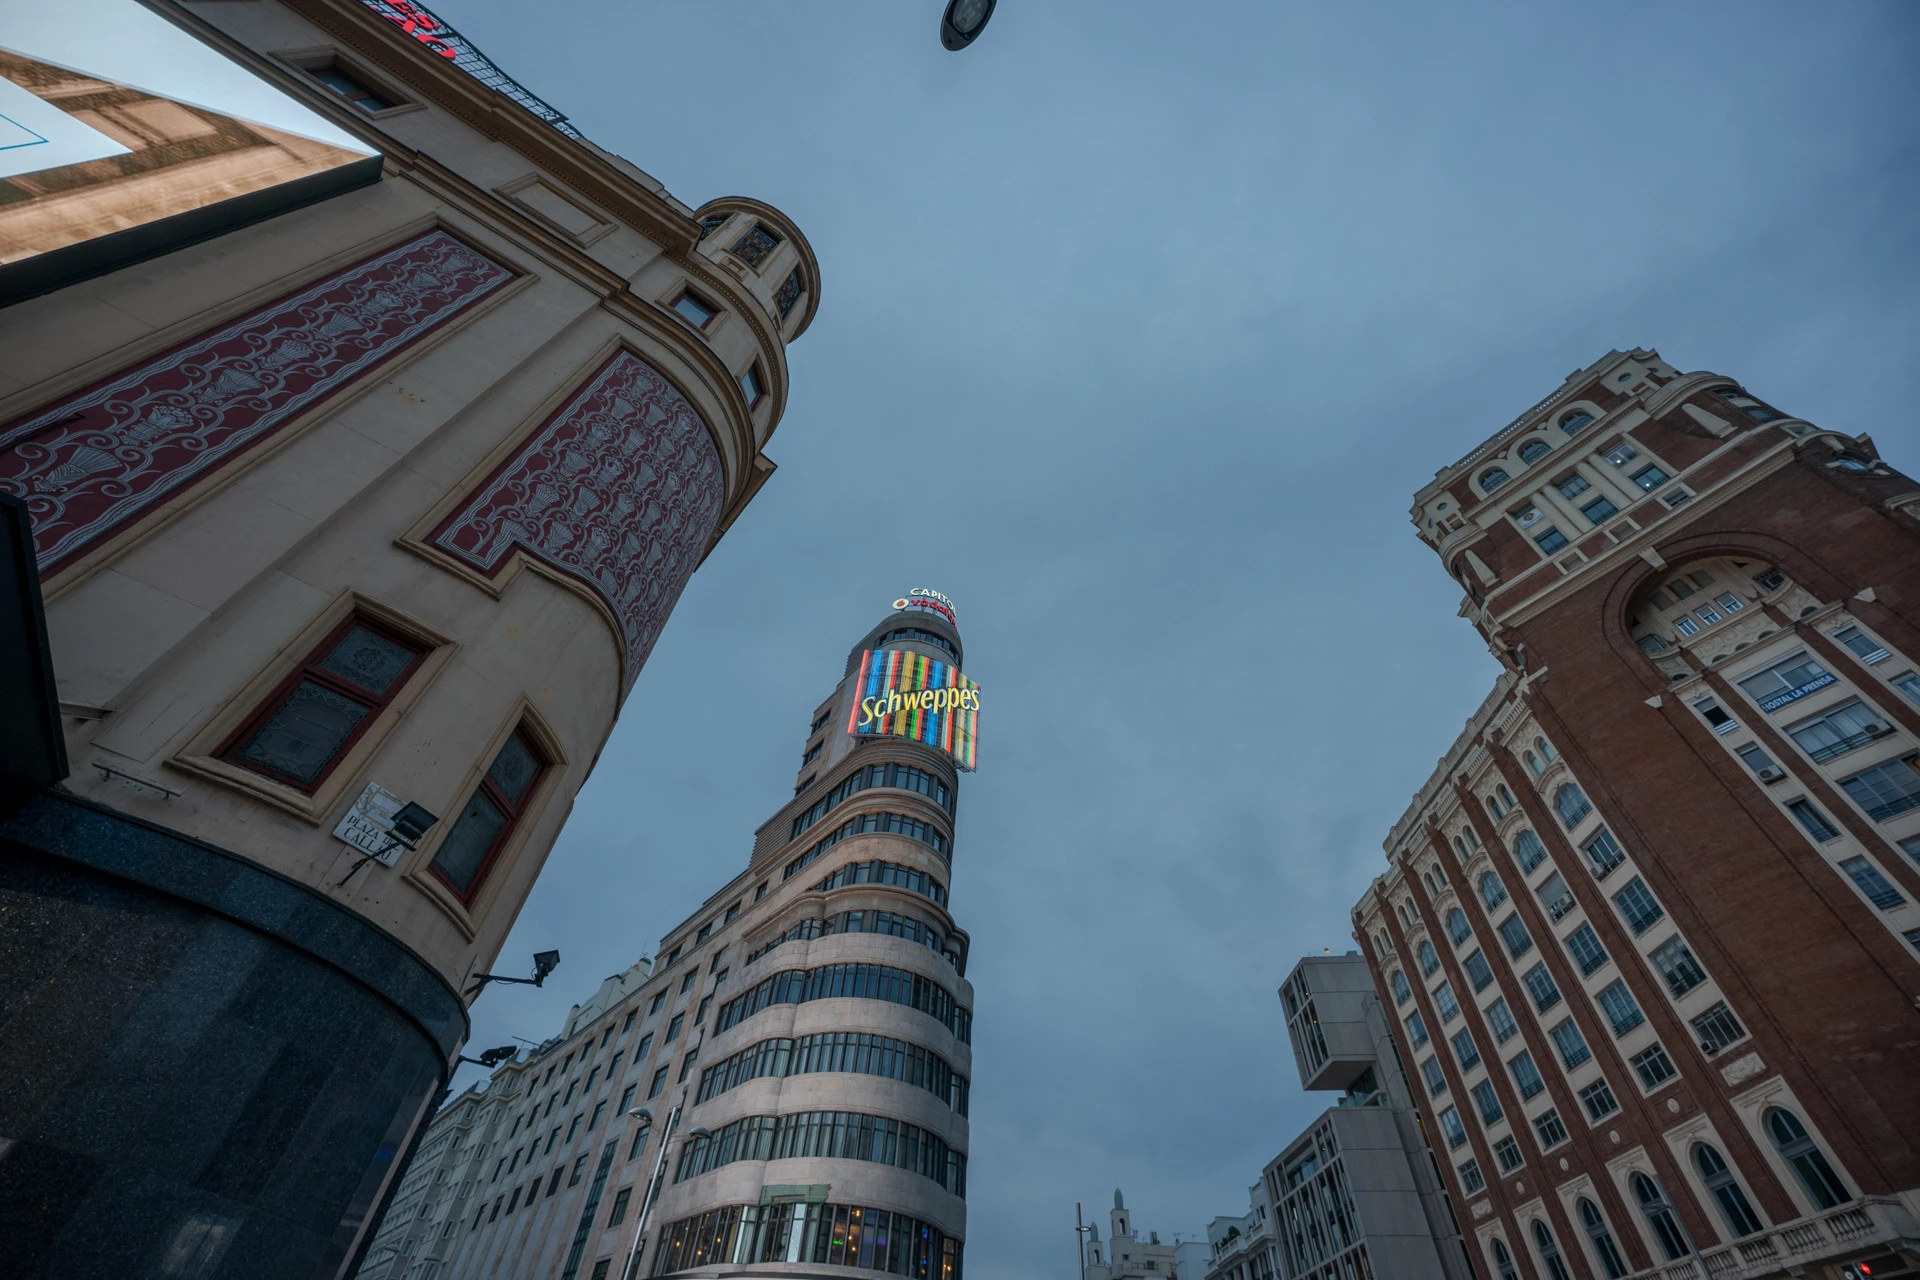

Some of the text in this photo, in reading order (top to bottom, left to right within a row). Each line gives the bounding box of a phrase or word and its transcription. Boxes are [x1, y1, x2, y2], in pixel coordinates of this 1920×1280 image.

[910, 587, 957, 617] CAPITOL
[858, 687, 980, 726] Schweppes
[1762, 675, 1835, 711] HOSTAL LA PRENSA
[347, 815, 379, 839] PLAZA
